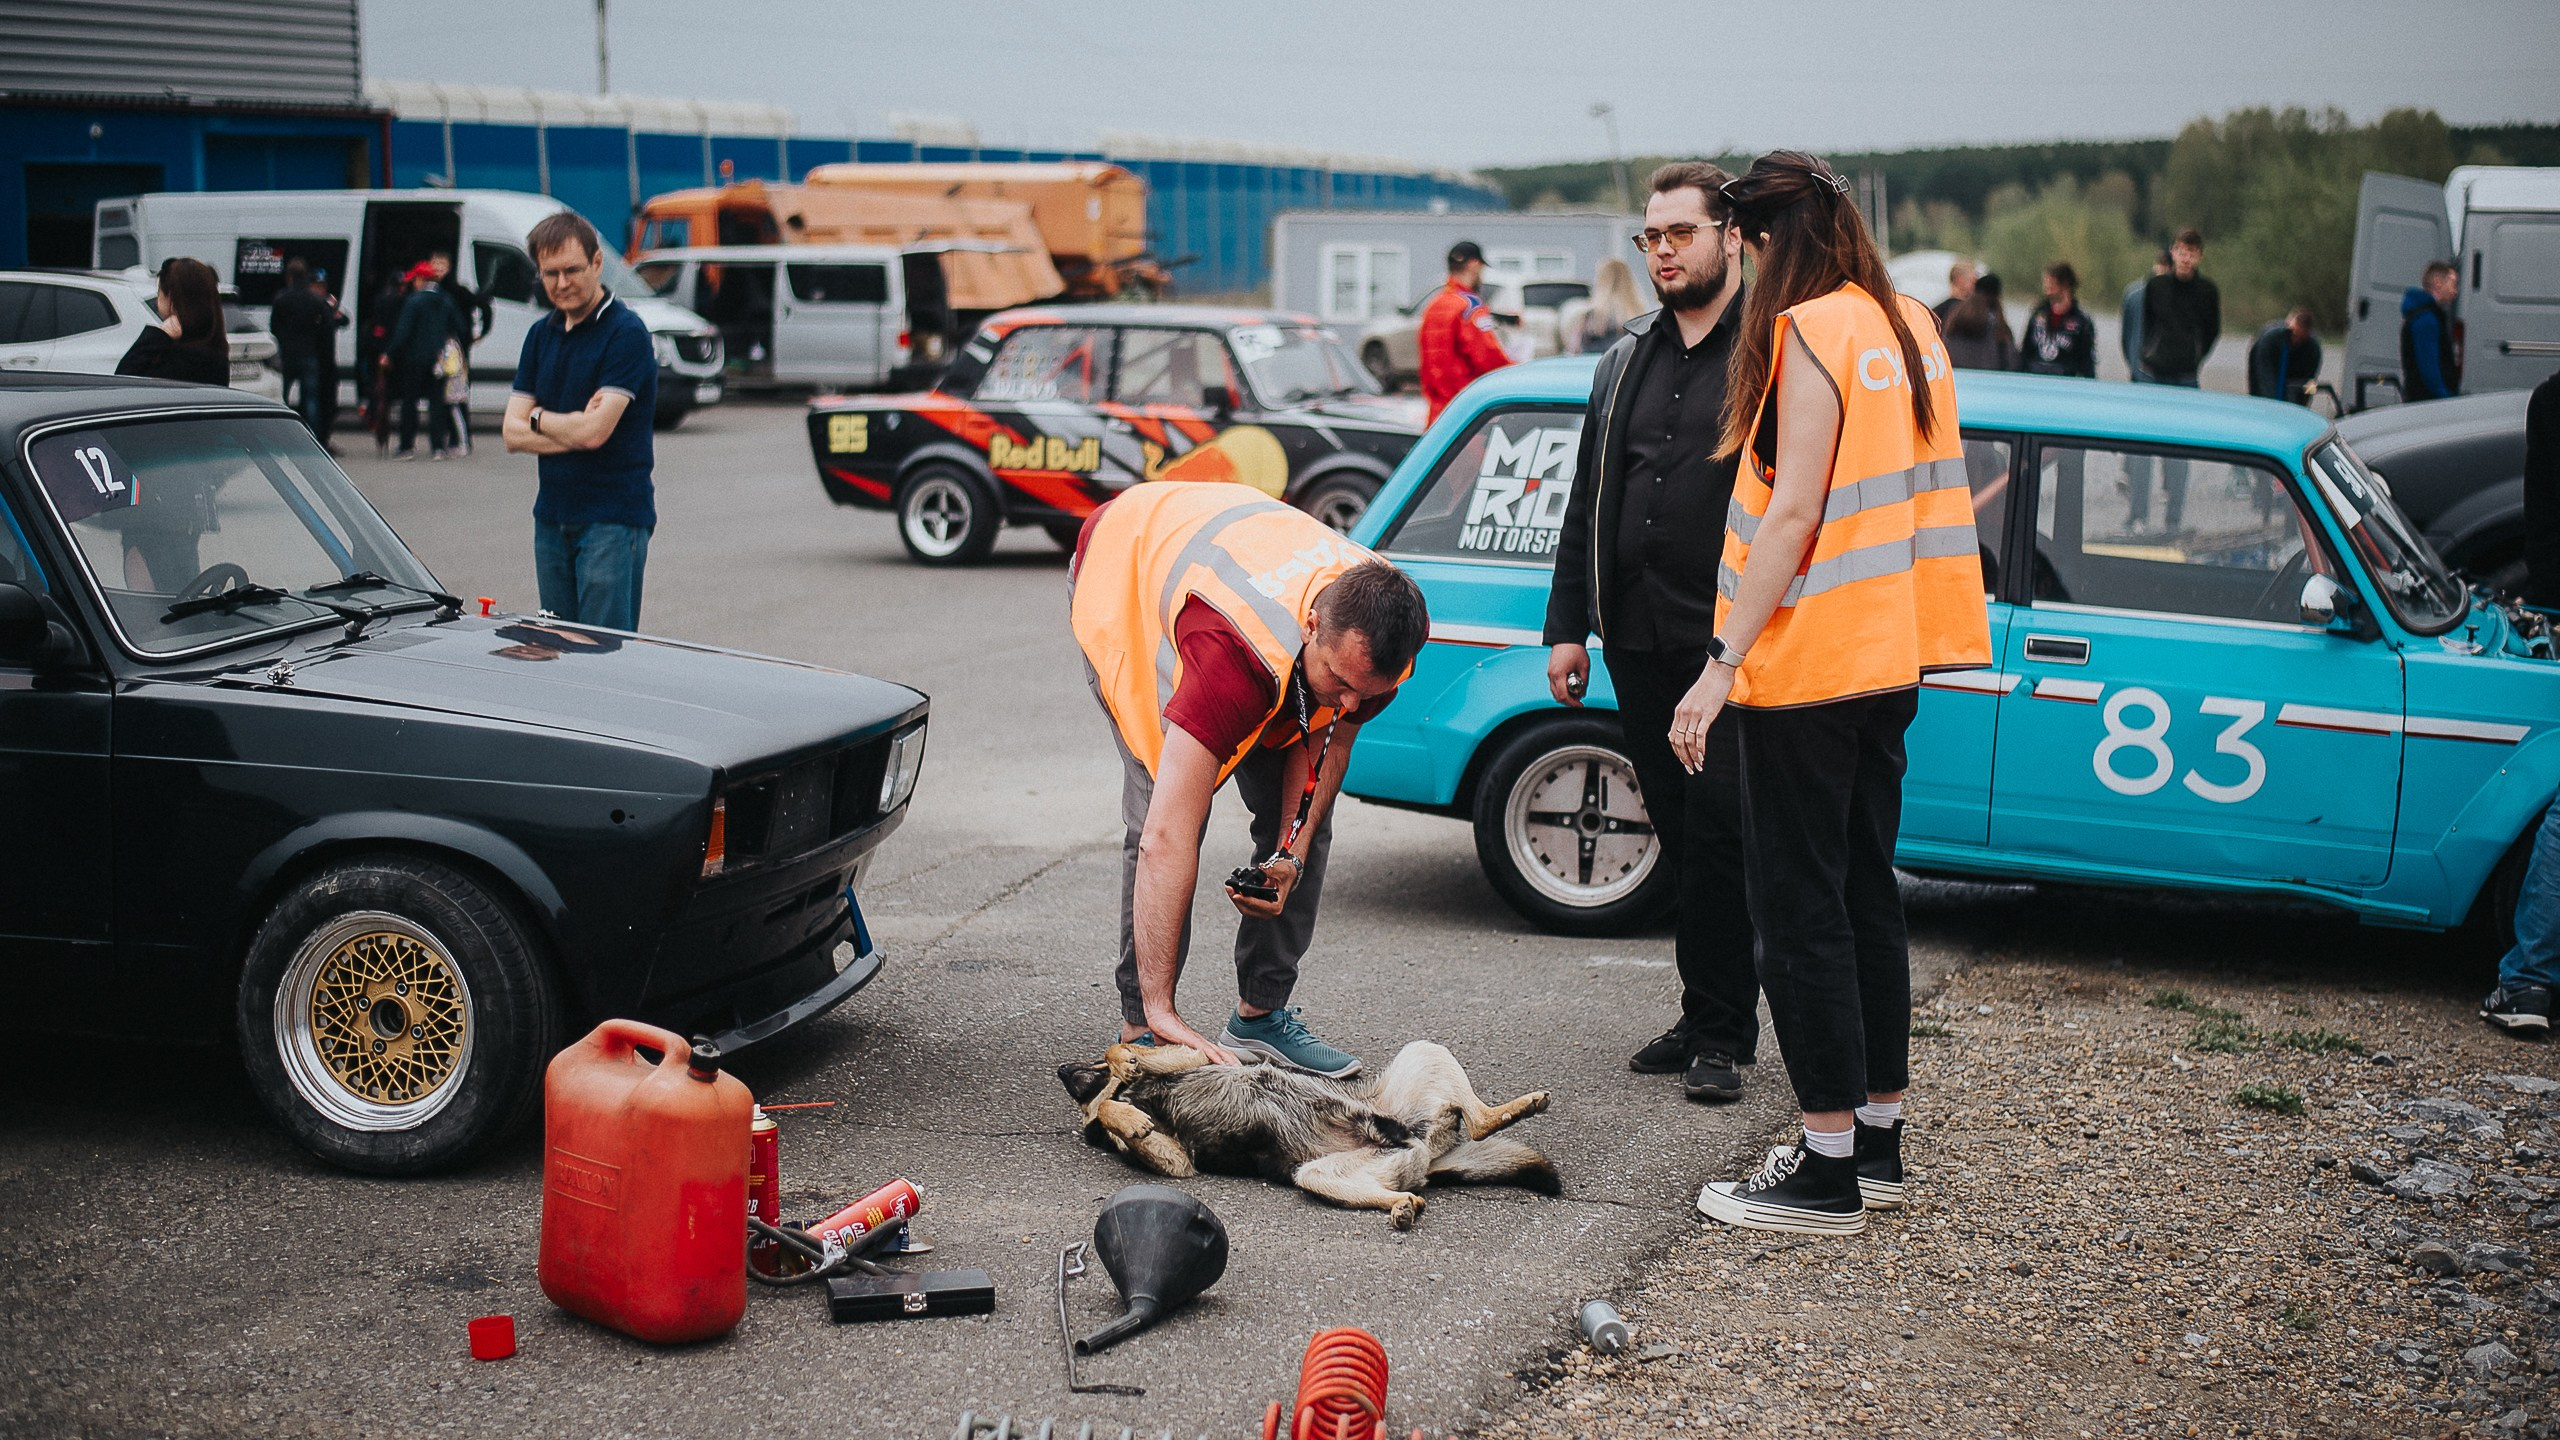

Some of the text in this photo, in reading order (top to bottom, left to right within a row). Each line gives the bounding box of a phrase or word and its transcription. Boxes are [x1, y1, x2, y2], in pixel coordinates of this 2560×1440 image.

[1858, 341, 1946, 391] СУЬЯ
[74, 447, 126, 494] 12
[989, 433, 1100, 471] Red Bull
[1480, 425, 1581, 480] MA
[1457, 524, 1561, 554] MOTORSP
[1246, 538, 1362, 599] УДЬЯ
[2092, 686, 2267, 804] 83
